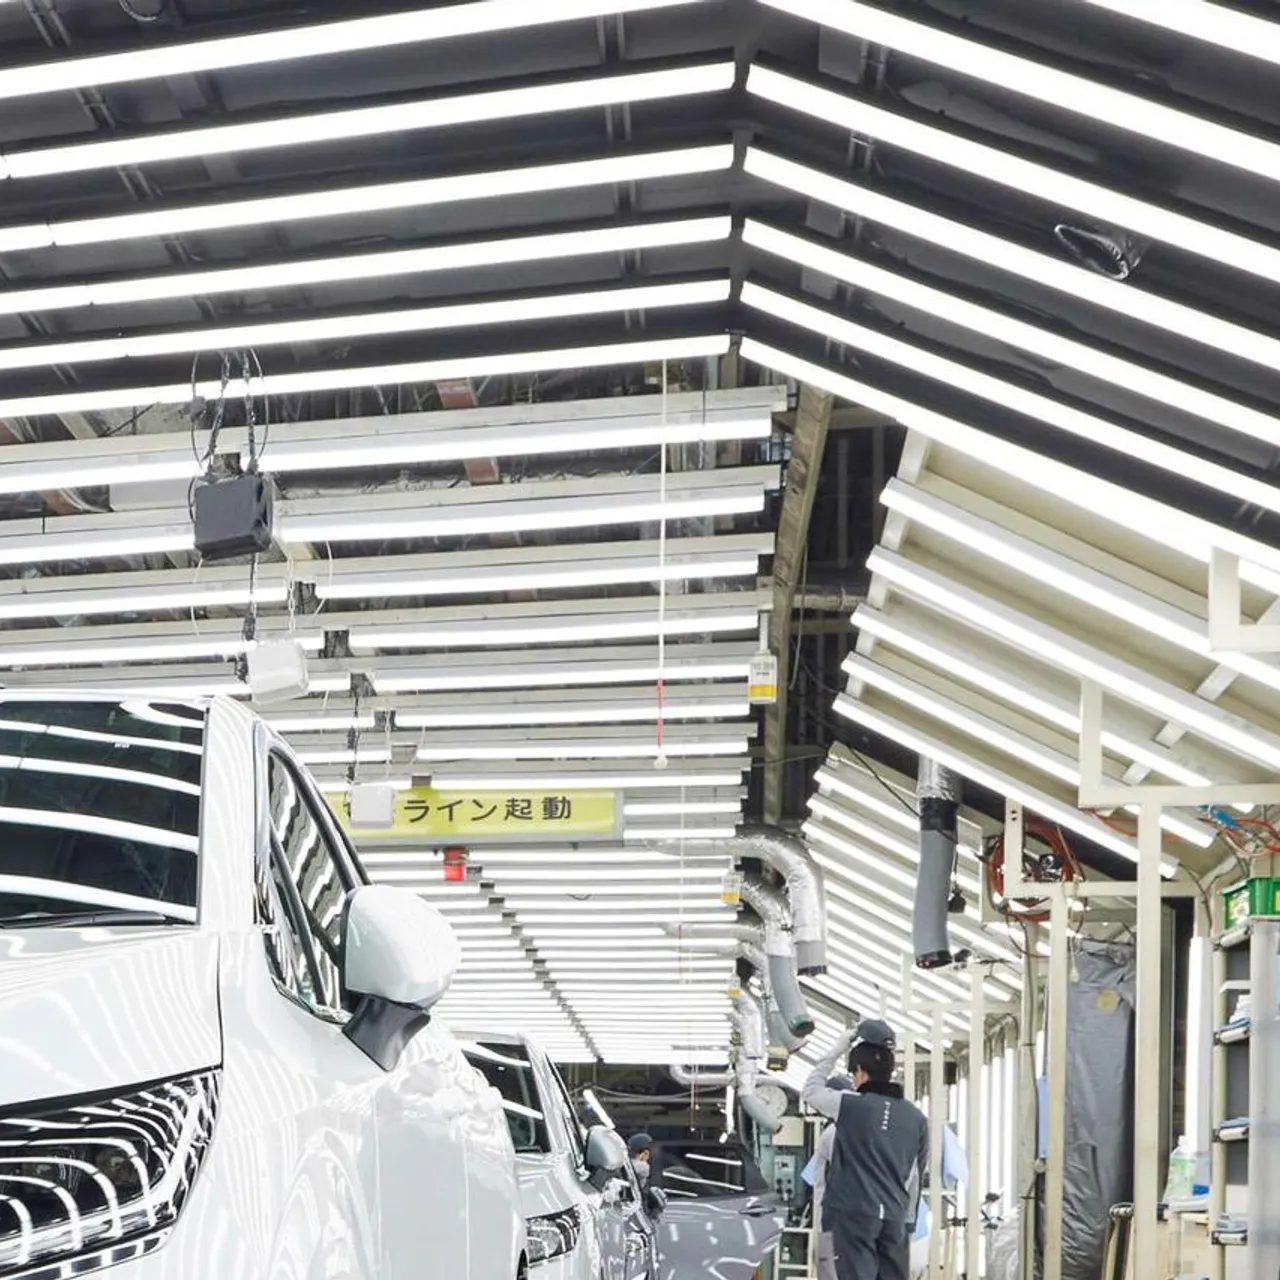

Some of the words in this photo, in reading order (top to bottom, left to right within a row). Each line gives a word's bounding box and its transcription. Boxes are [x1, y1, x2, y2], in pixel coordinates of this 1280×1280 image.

[403, 796, 572, 823] ライン起動
